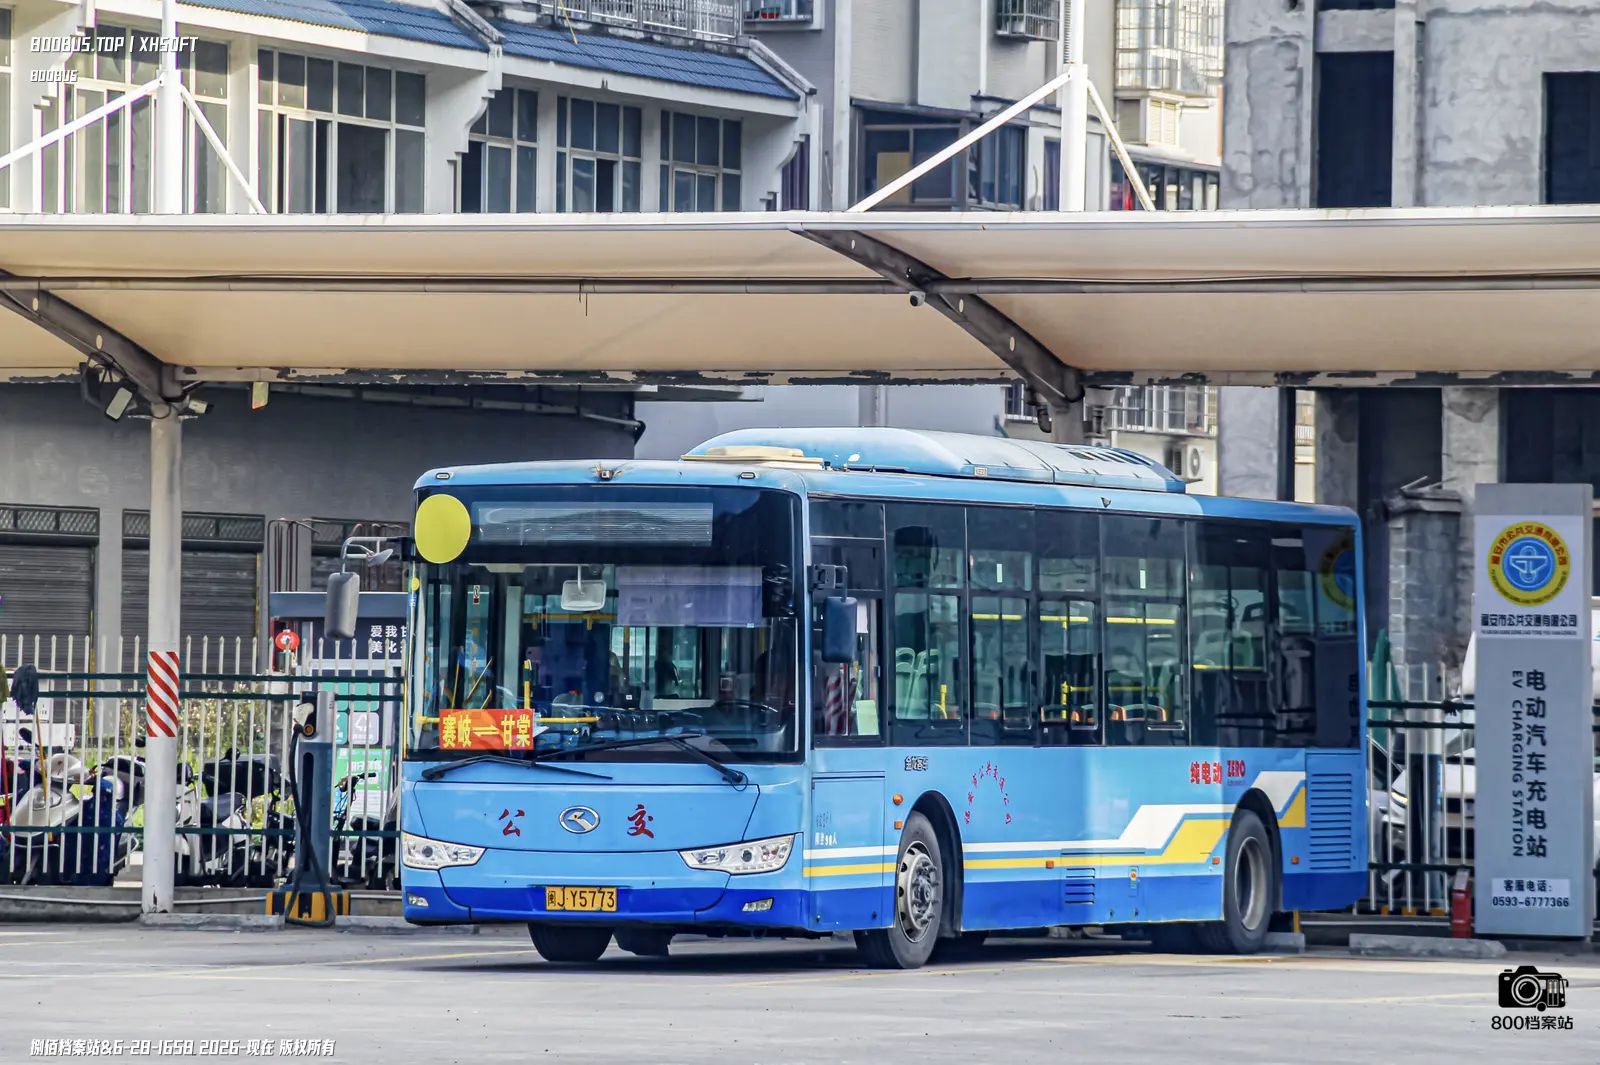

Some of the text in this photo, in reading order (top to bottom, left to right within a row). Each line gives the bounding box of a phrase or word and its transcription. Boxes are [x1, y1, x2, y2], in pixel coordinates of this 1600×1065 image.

[501, 714, 531, 747] 甘棠
[1190, 760, 1246, 784] 纯电动 ZERO
[1512, 670, 1523, 857] EV CHARGING STATION
[1526, 669, 1547, 858] 电动汽车充电站
[499, 804, 654, 838] 公 交
[1492, 896, 1570, 907] 0593-6777366
